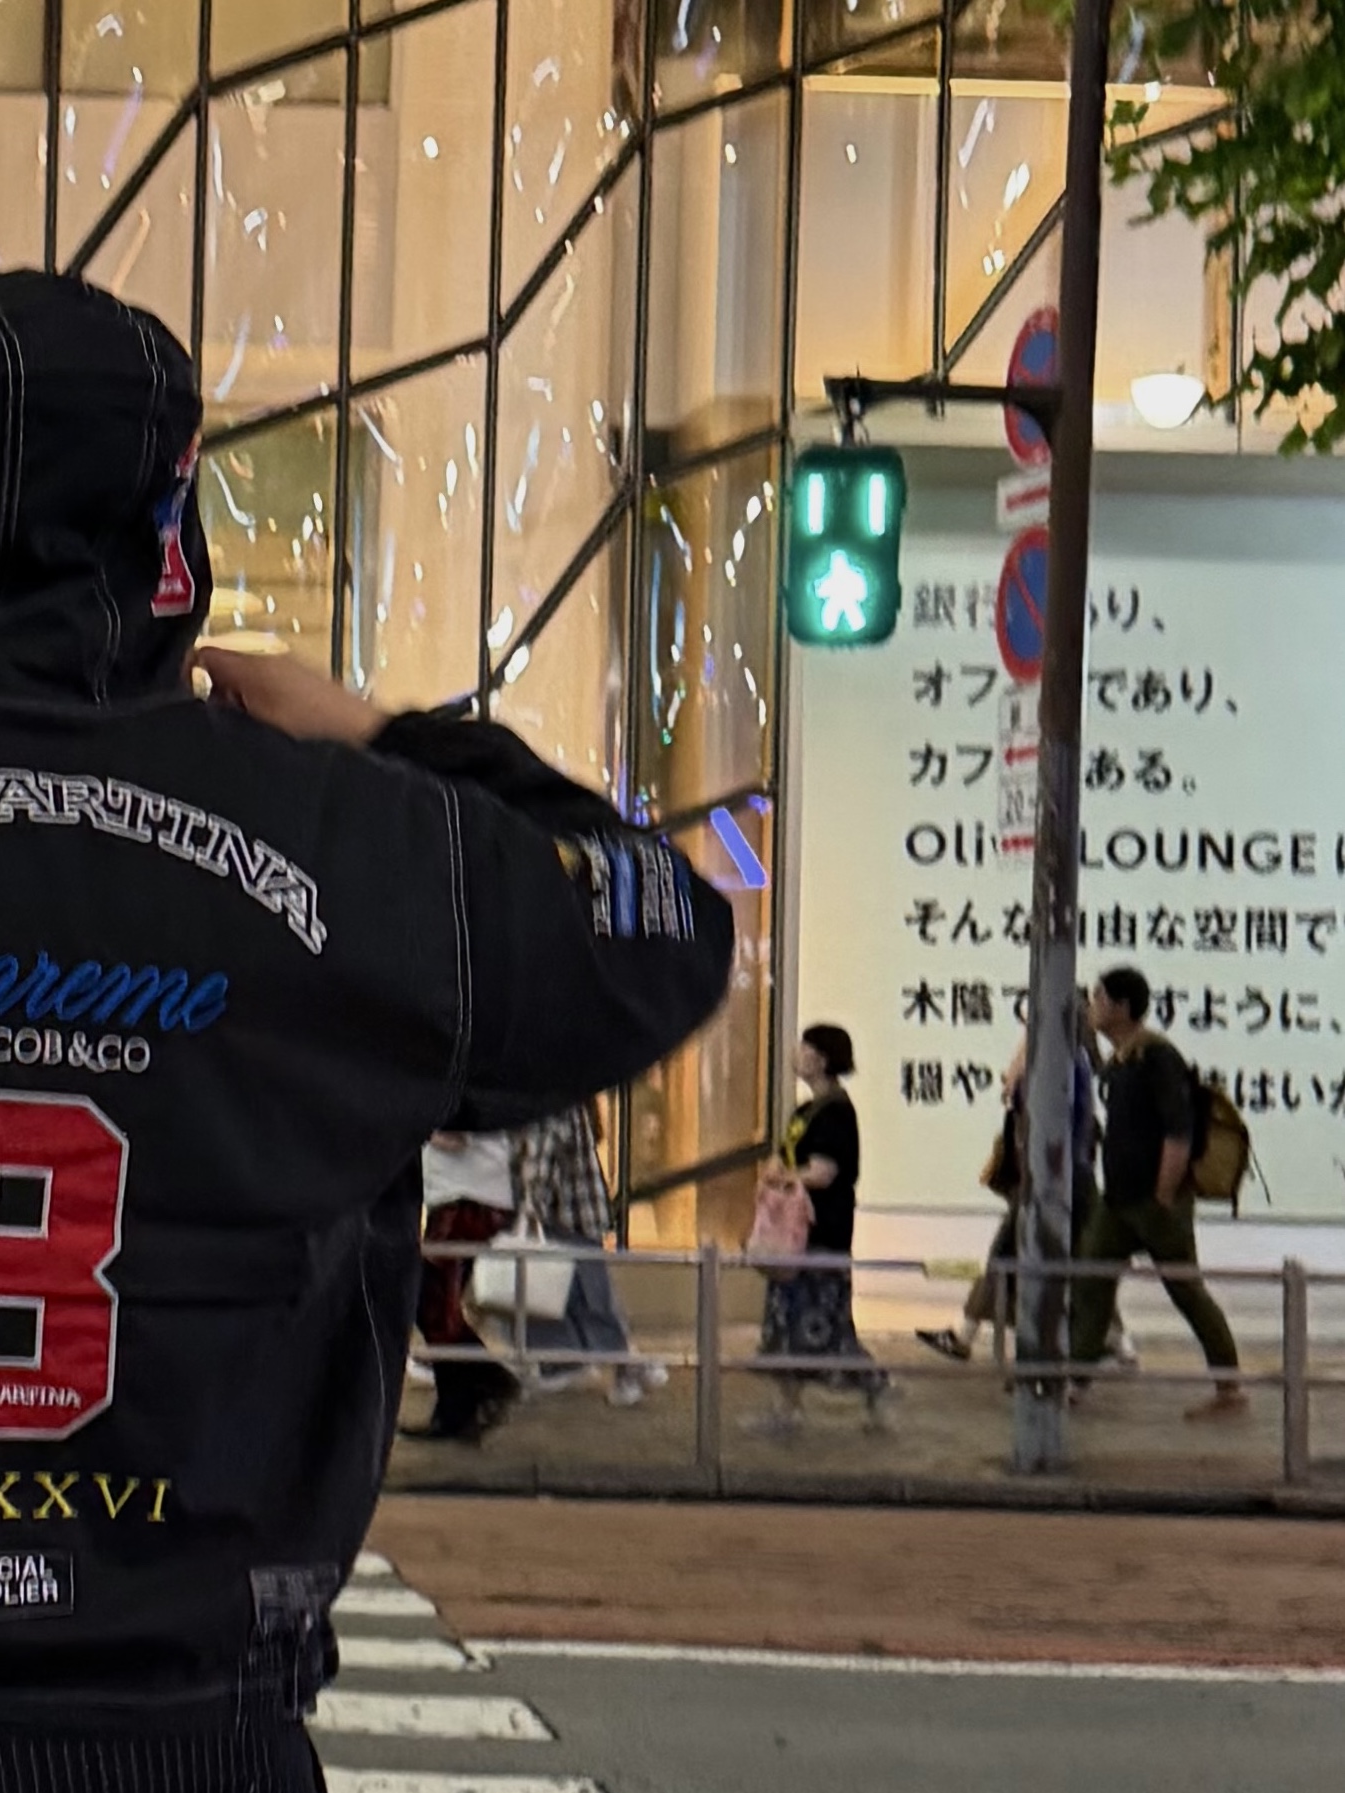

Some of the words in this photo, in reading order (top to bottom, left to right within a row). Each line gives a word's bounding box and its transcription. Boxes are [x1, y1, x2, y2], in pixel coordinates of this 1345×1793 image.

[911, 581, 1166, 636] 銀行り、
[910, 657, 1239, 716] オフであり、
[908, 741, 1197, 797] カフある。
[1078, 827, 1317, 877] LOUNGE
[901, 975, 1345, 1036] 木陰ですように、
